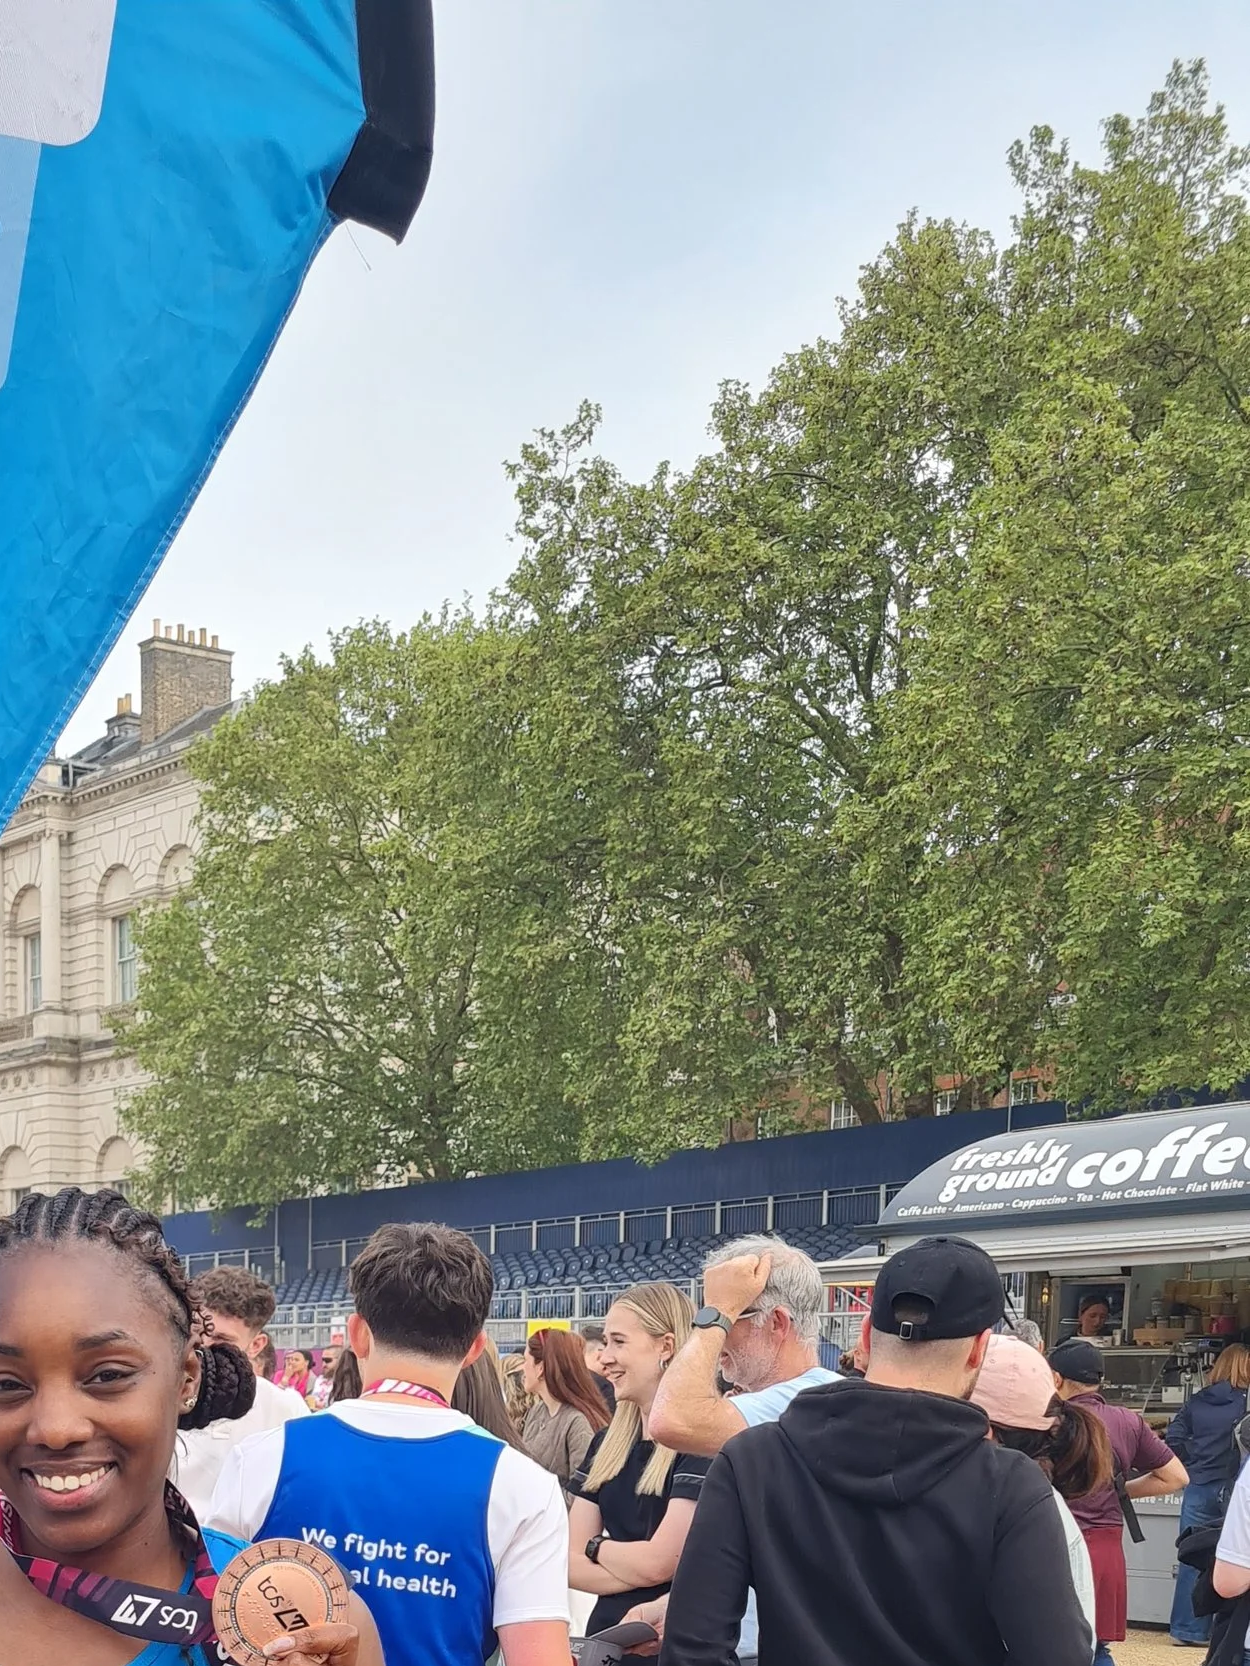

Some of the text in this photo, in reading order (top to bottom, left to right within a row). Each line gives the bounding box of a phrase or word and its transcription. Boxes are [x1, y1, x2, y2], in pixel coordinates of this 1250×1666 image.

[950, 1138, 1073, 1172] freshly
[1067, 1122, 1250, 1189] coffe
[922, 1205, 947, 1216] Latte
[953, 1201, 1004, 1213] Americano
[1011, 1195, 1068, 1209] Cappuccino
[1076, 1192, 1094, 1202] Tea
[1101, 1189, 1121, 1201] Hot
[1123, 1185, 1178, 1199] Chocolate
[1185, 1181, 1208, 1194] Flat
[1210, 1178, 1244, 1191] White
[938, 1156, 1068, 1203] ground
[301, 1527, 452, 1567] We fight for
[377, 1569, 457, 1599] health
[159, 1606, 198, 1634] tcs
